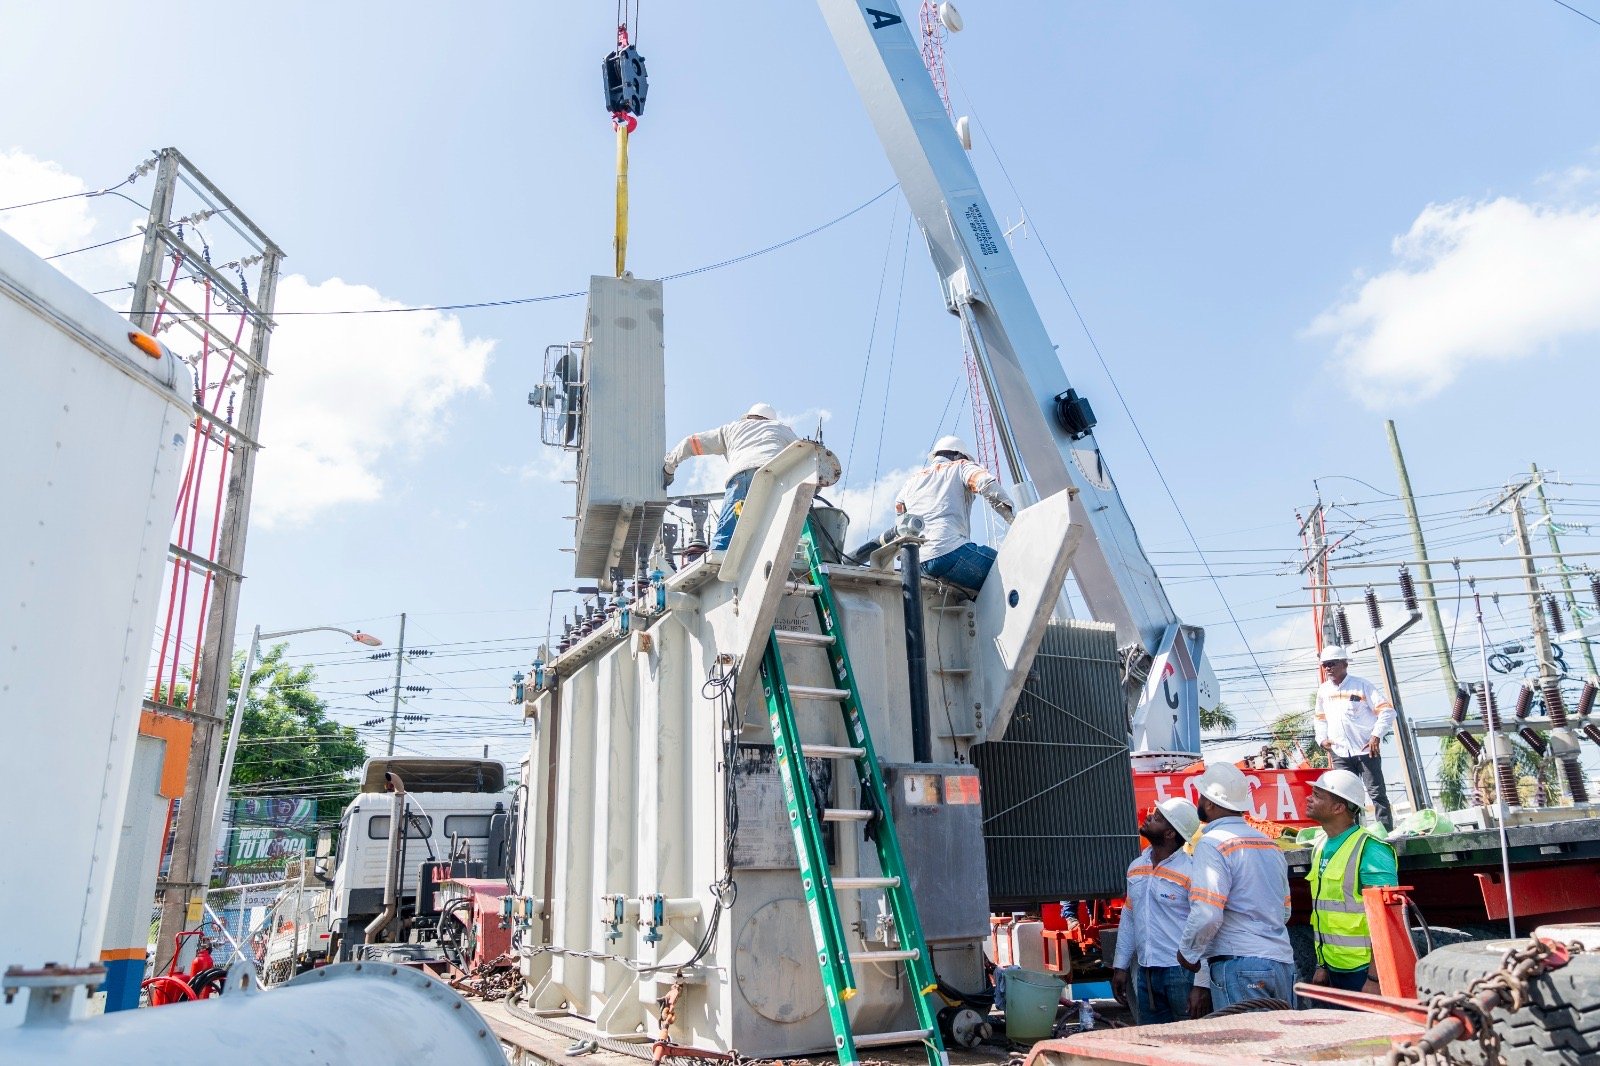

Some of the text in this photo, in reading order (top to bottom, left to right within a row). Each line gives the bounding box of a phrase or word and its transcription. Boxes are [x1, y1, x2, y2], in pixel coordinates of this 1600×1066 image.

[865, 7, 903, 30] A
[736, 747, 761, 761] ABB
[1154, 773, 1299, 821] FOCA
[239, 829, 270, 839] IMPULSA
[236, 838, 306, 859] TU MRCA
